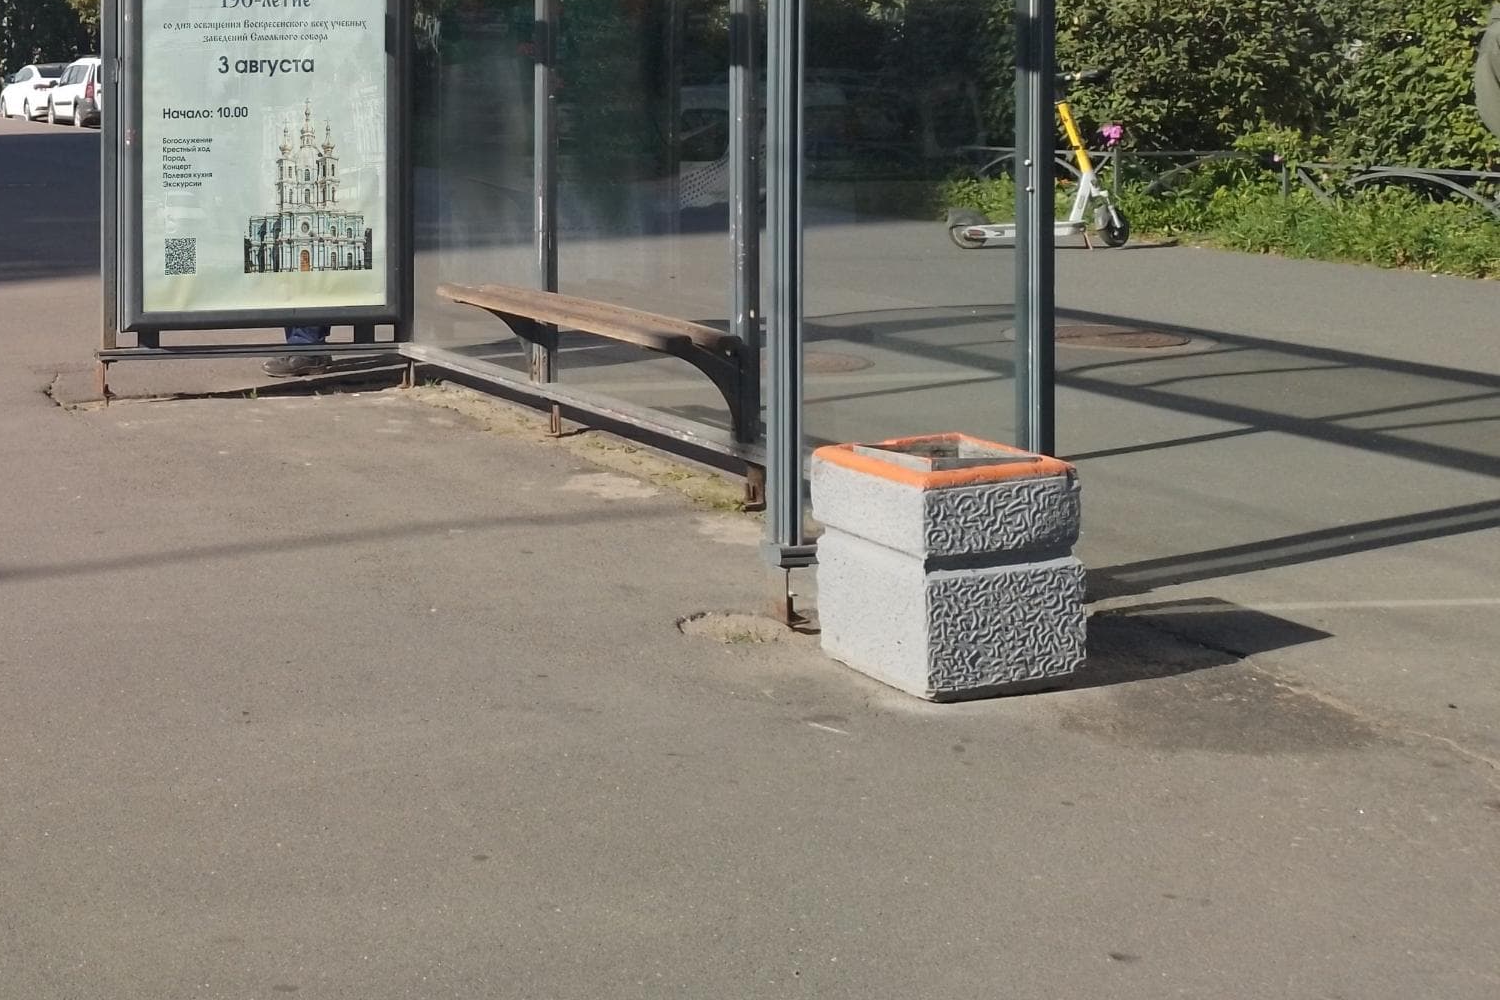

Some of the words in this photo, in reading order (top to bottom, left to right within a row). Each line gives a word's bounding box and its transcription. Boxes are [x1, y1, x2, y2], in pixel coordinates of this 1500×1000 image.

[174, 22, 191, 30] дня
[193, 22, 241, 30] освящения
[243, 19, 309, 30] Воскресенского
[311, 20, 329, 30] всех
[330, 20, 367, 30] учебных
[202, 33, 248, 43] заведений
[250, 32, 298, 41] Смольного
[300, 33, 328, 43] собора
[217, 55, 230, 74] 3
[234, 58, 315, 77] августа
[162, 107, 213, 119] Начало:
[217, 106, 248, 118] 10.00
[162, 145, 196, 153] Крестный
